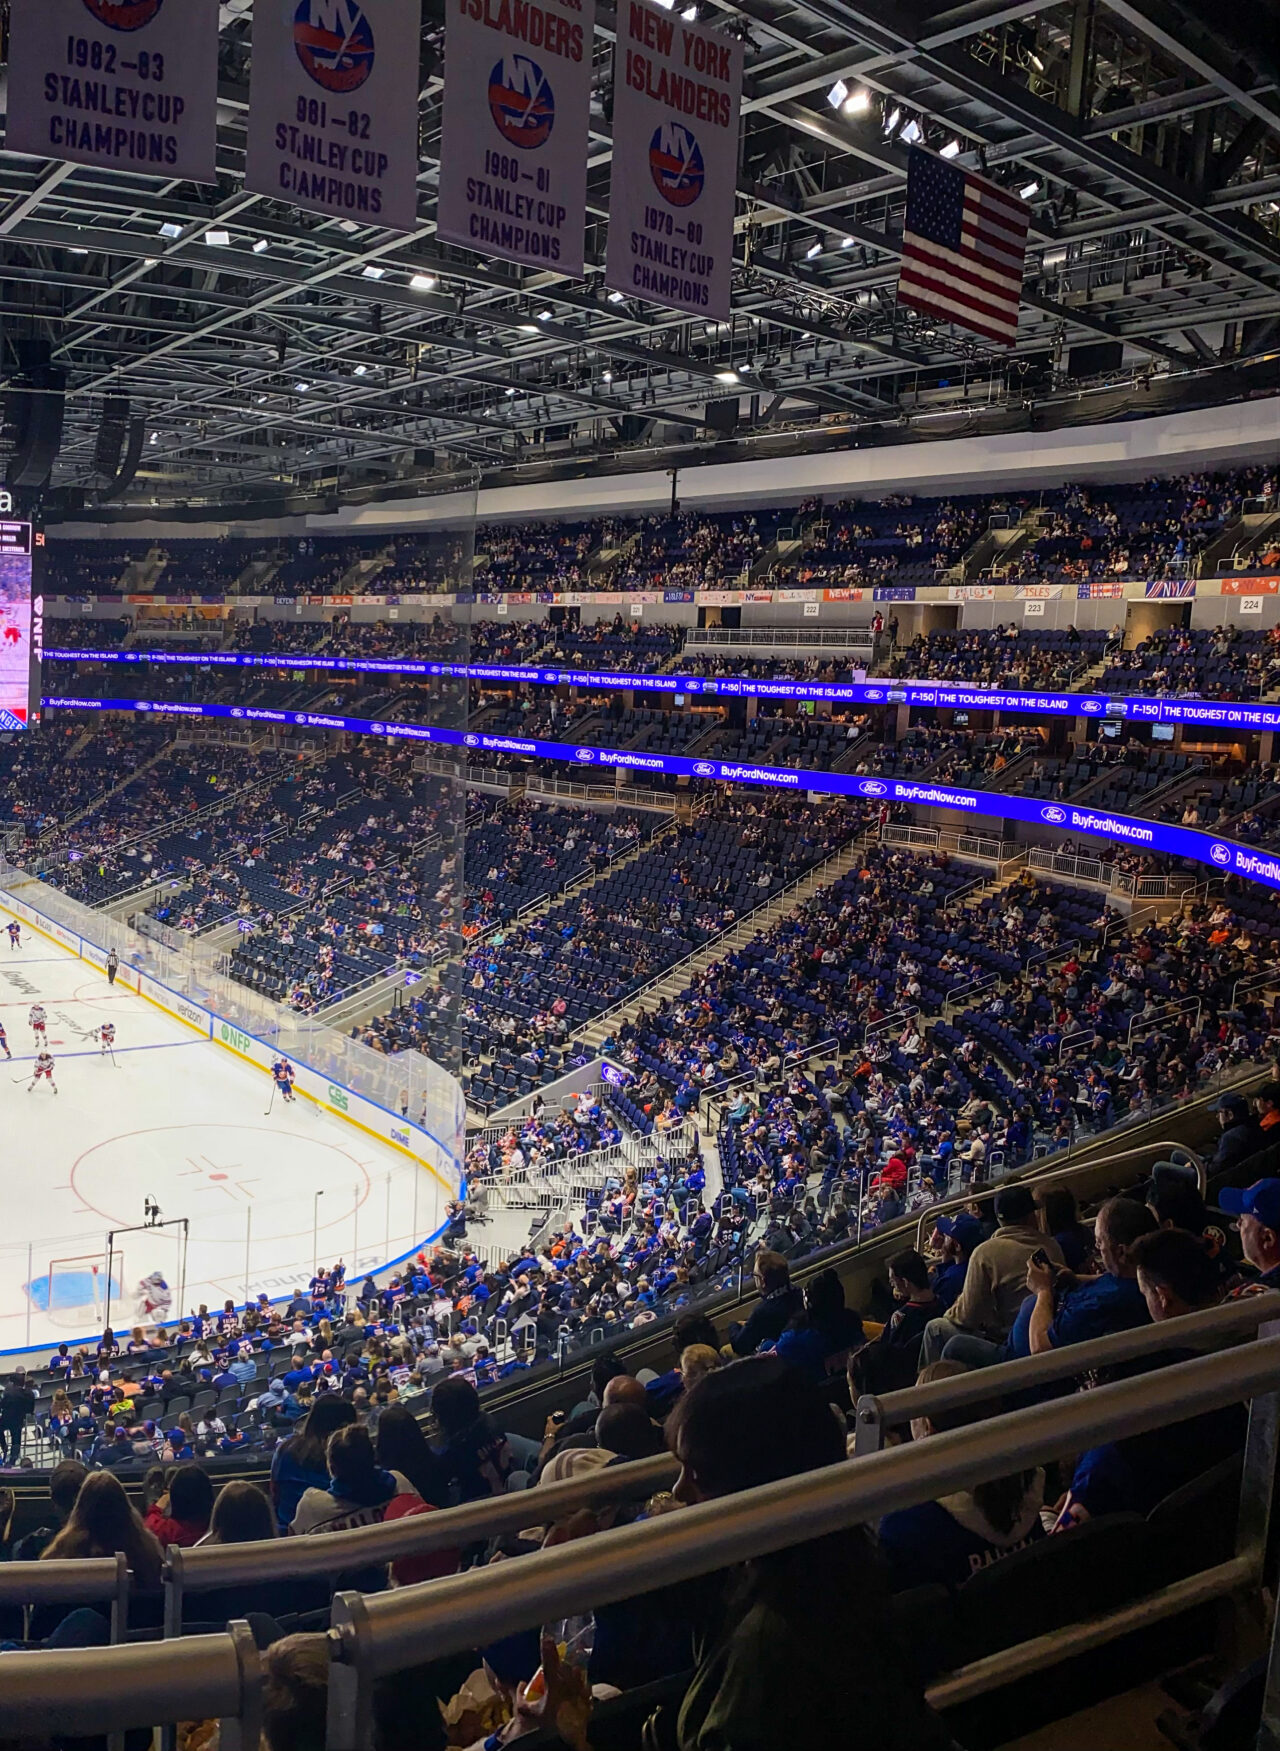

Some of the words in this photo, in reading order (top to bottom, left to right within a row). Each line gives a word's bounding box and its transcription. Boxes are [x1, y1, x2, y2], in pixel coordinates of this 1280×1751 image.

[629, 2, 674, 56] NEW
[683, 29, 731, 83] YORK
[626, 48, 731, 128] ISLANDERS
[50, 115, 177, 165] CHAMPIONS
[351, 148, 388, 178] CUP
[467, 177, 535, 221] STANLEY
[537, 201, 566, 229] CUP
[470, 212, 560, 261] CHAMPIONS
[631, 231, 688, 268] STANLEY
[690, 252, 714, 277] CUP
[633, 263, 709, 306] CHAMPIONS
[1024, 586, 1051, 597] ISLES
[1028, 604, 1042, 612] 223
[1243, 601, 1259, 609] 224
[600, 677, 631, 685] TOUGHEST
[632, 678, 641, 686] ON
[654, 680, 676, 688] ISLAND
[721, 683, 738, 691] F-150
[742, 684, 755, 692] THE
[757, 685, 794, 694] TOUGHEST
[796, 687, 807, 695] ON
[809, 687, 822, 696] THE
[824, 688, 853, 697] ISLAND
[49, 699, 102, 707] BuyFordNow.com
[911, 692, 933, 701] F-150
[939, 694, 956, 702] THE
[958, 694, 1005, 705] TOUGHEST
[1007, 697, 1018, 706] ON
[1020, 698, 1036, 707] THE
[1038, 699, 1068, 709] ISLAND
[1132, 704, 1158, 715] F-150
[1164, 706, 1181, 716] THE
[1183, 708, 1226, 720] TOUGHEST
[1229, 711, 1241, 721] ON
[1243, 712, 1260, 723] THE
[483, 737, 536, 751] BuyFordNow.com
[600, 752, 663, 768] BuyFordNow.com
[721, 765, 798, 783] BuyFordNow.com
[895, 785, 977, 807] BuyFordNow.com
[1072, 812, 1153, 841] BuyFordNow.com
[177, 1002, 202, 1025] verizon
[229, 1026, 251, 1053] NFP
[390, 1128, 410, 1148] DIME
